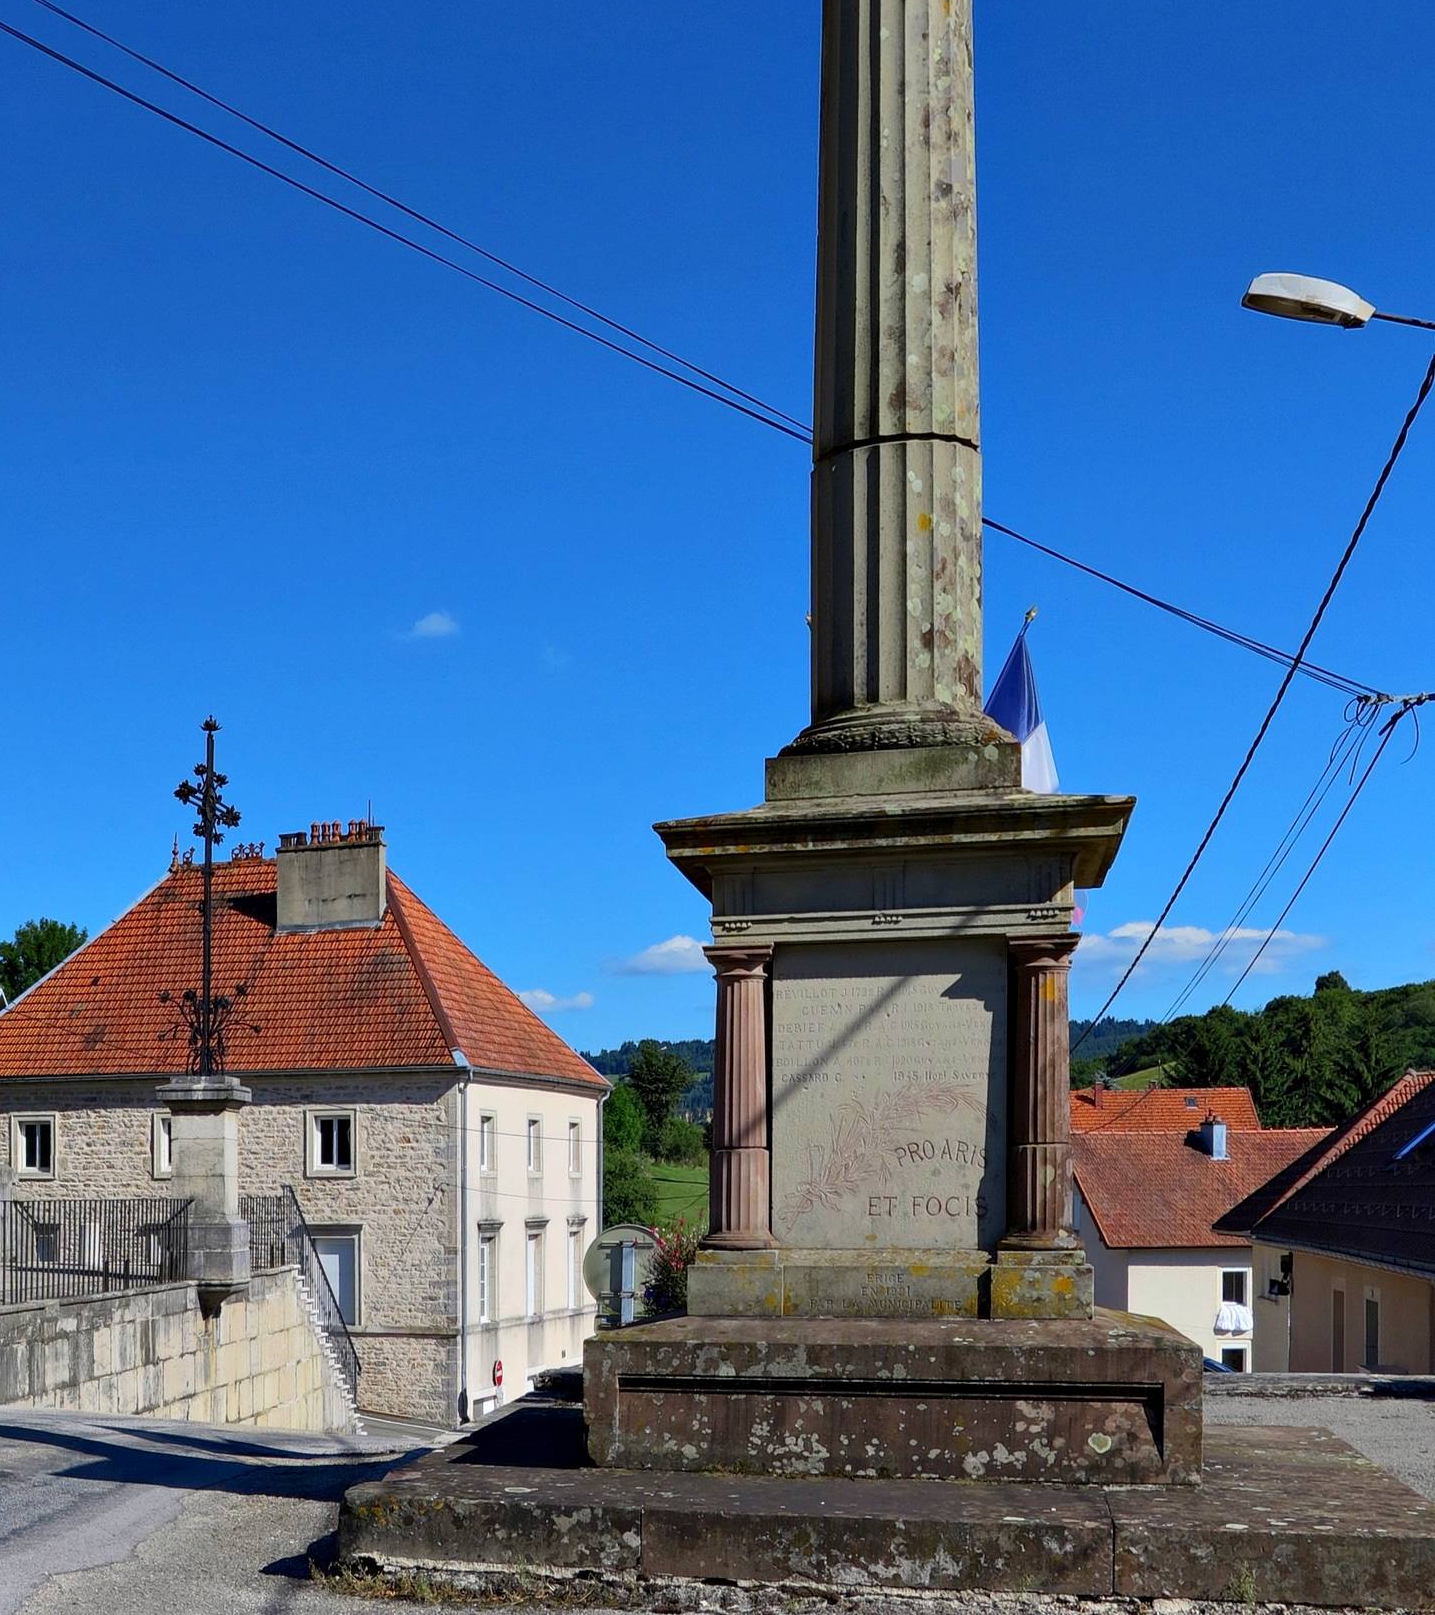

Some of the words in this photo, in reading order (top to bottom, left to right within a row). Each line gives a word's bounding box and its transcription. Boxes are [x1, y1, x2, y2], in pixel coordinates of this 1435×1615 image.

[894, 1139, 935, 1168] PRO
[939, 1137, 988, 1170] ARIS
[868, 1195, 898, 1217] ET
[912, 1195, 988, 1218] FOCIS
